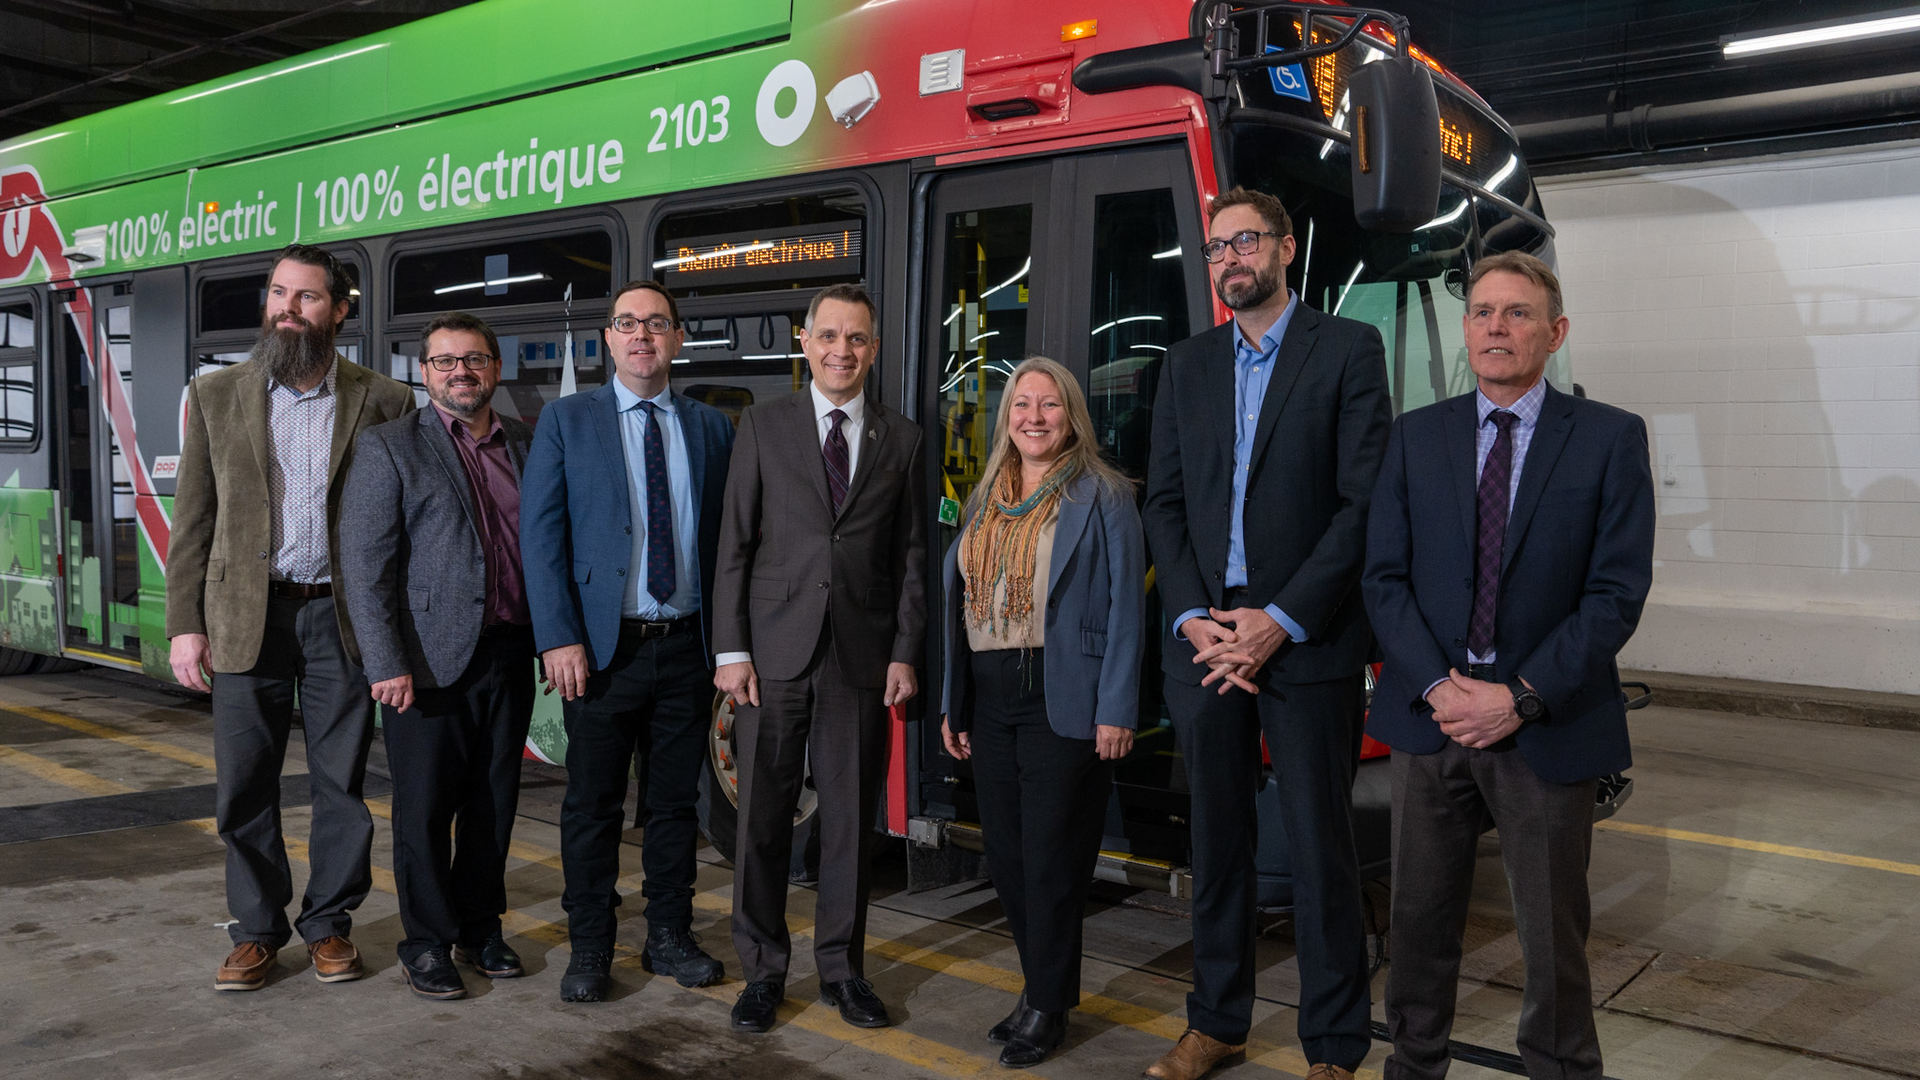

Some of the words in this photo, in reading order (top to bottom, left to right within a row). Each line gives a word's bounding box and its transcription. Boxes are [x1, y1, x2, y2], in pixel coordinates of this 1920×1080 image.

[647, 95, 731, 153] 2103
[1440, 118, 1463, 160] tric
[108, 210, 171, 261] 100%
[179, 191, 278, 250] electric
[314, 165, 404, 228] 100%
[418, 137, 624, 204] électrique
